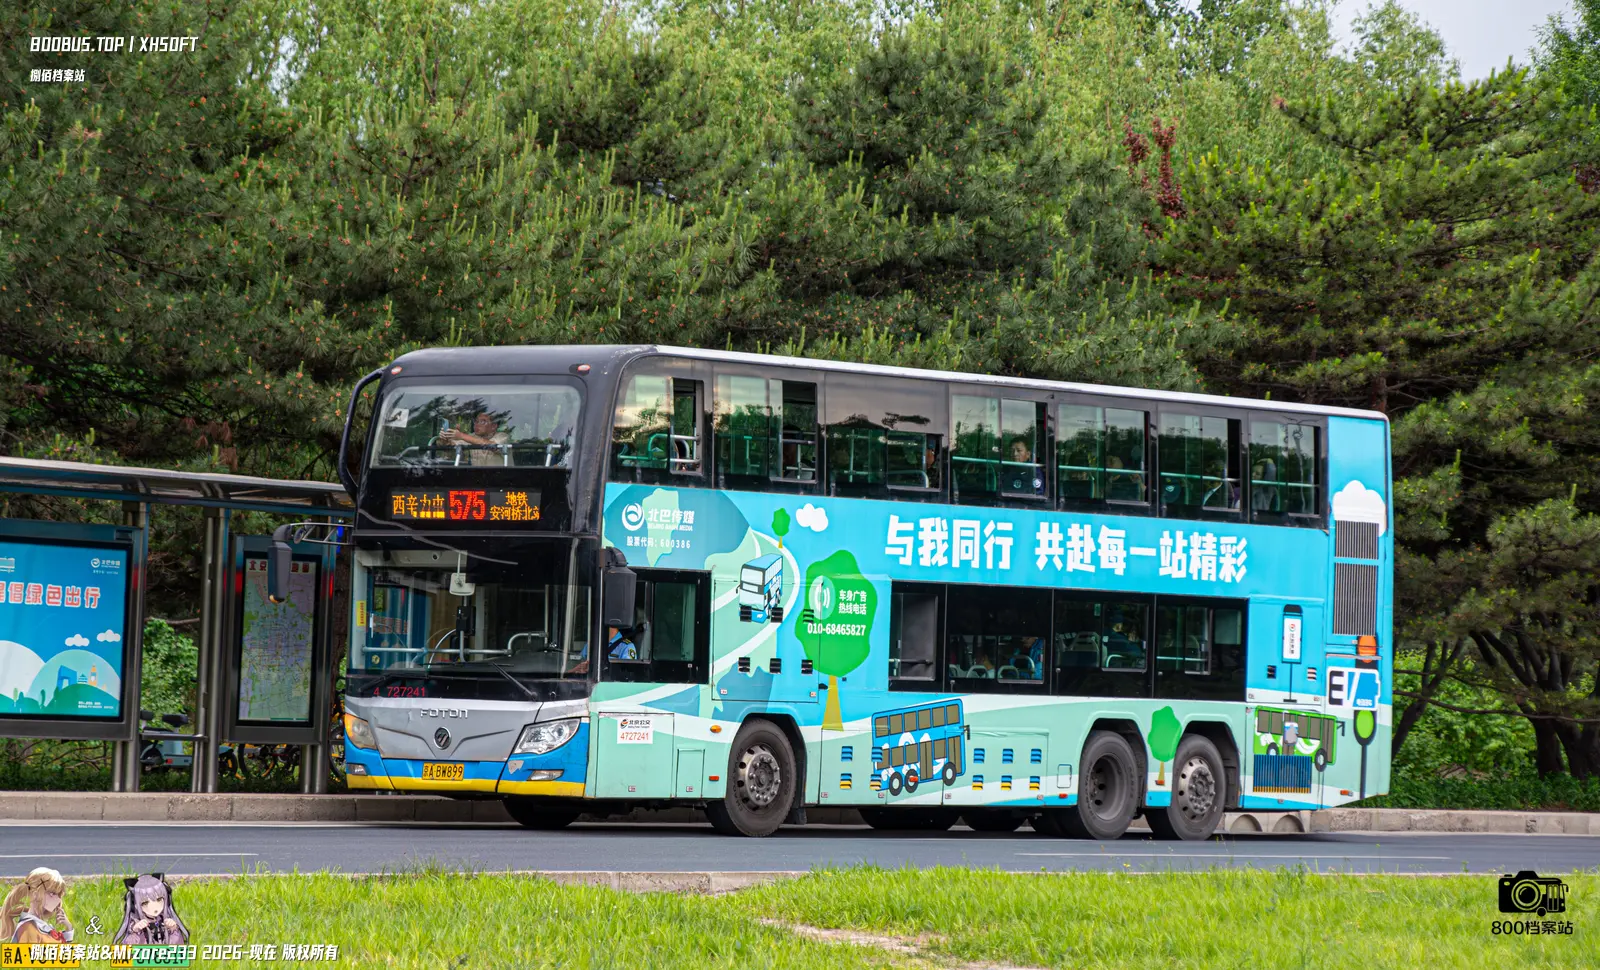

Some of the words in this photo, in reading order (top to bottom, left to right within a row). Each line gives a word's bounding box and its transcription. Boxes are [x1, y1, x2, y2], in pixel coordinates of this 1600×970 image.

[449, 490, 486, 520] 575
[505, 492, 528, 506] 地铁
[648, 508, 695, 524] 北巴传媒
[885, 514, 1013, 570] 与我同行
[1035, 522, 1247, 583] 共赴每一站精彩
[839, 589, 866, 602] 车身广告
[838, 602, 866, 614] 热线电话
[807, 623, 866, 636] 010-68465827
[420, 709, 468, 718] FOTON
[620, 732, 648, 740] 4727241
